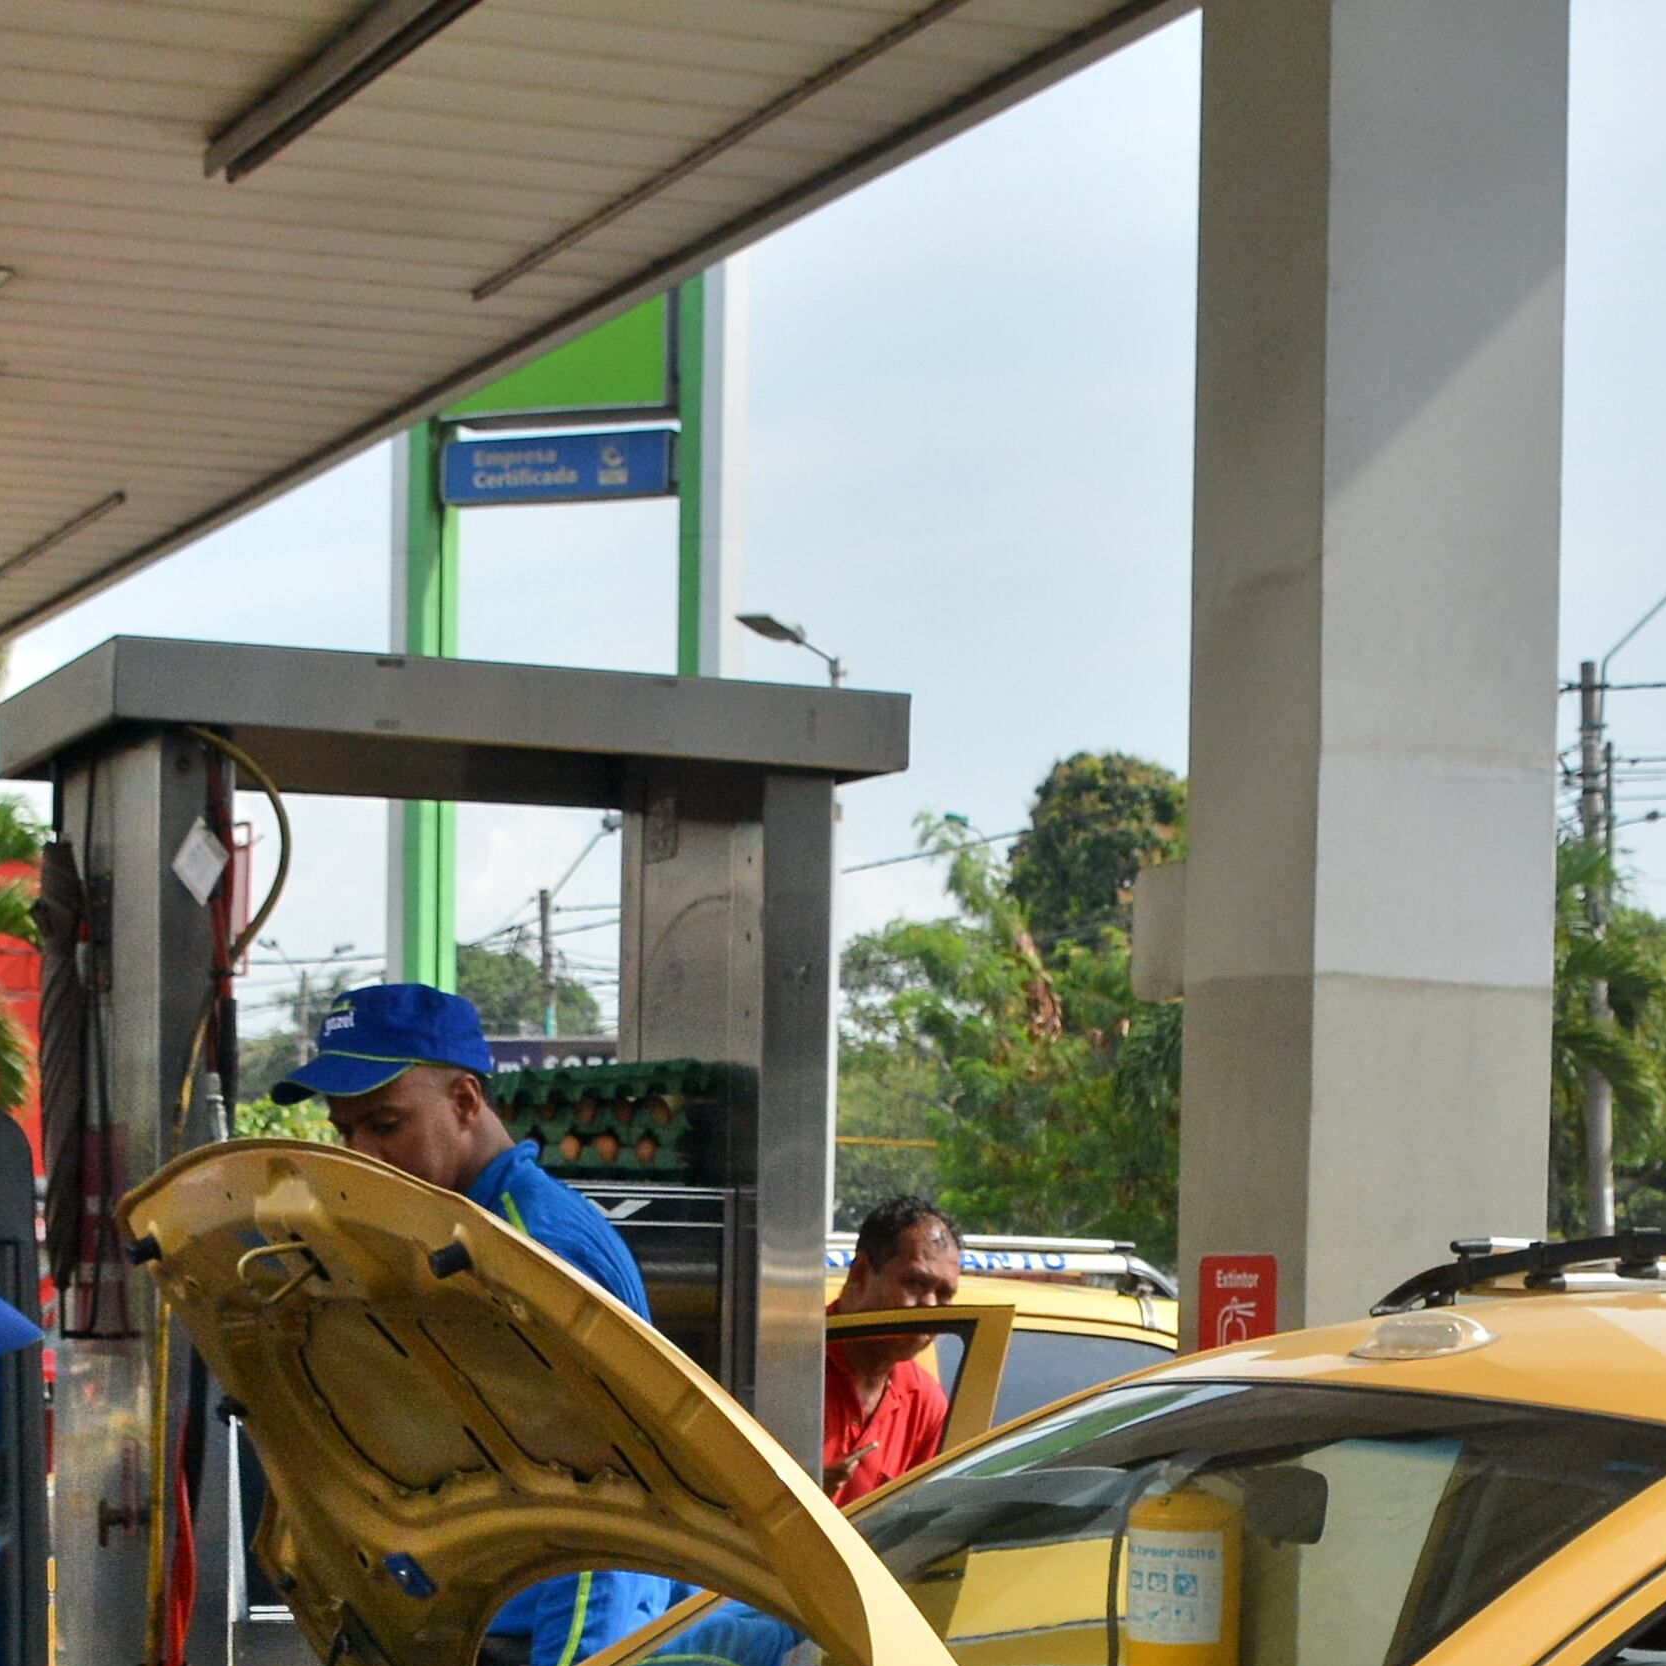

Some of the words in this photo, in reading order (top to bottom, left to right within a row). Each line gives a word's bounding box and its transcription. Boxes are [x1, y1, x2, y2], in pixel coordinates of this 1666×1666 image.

[472, 450, 558, 468] Empresa
[472, 465, 579, 489] Certificada
[1215, 1269, 1260, 1289] Extintor
